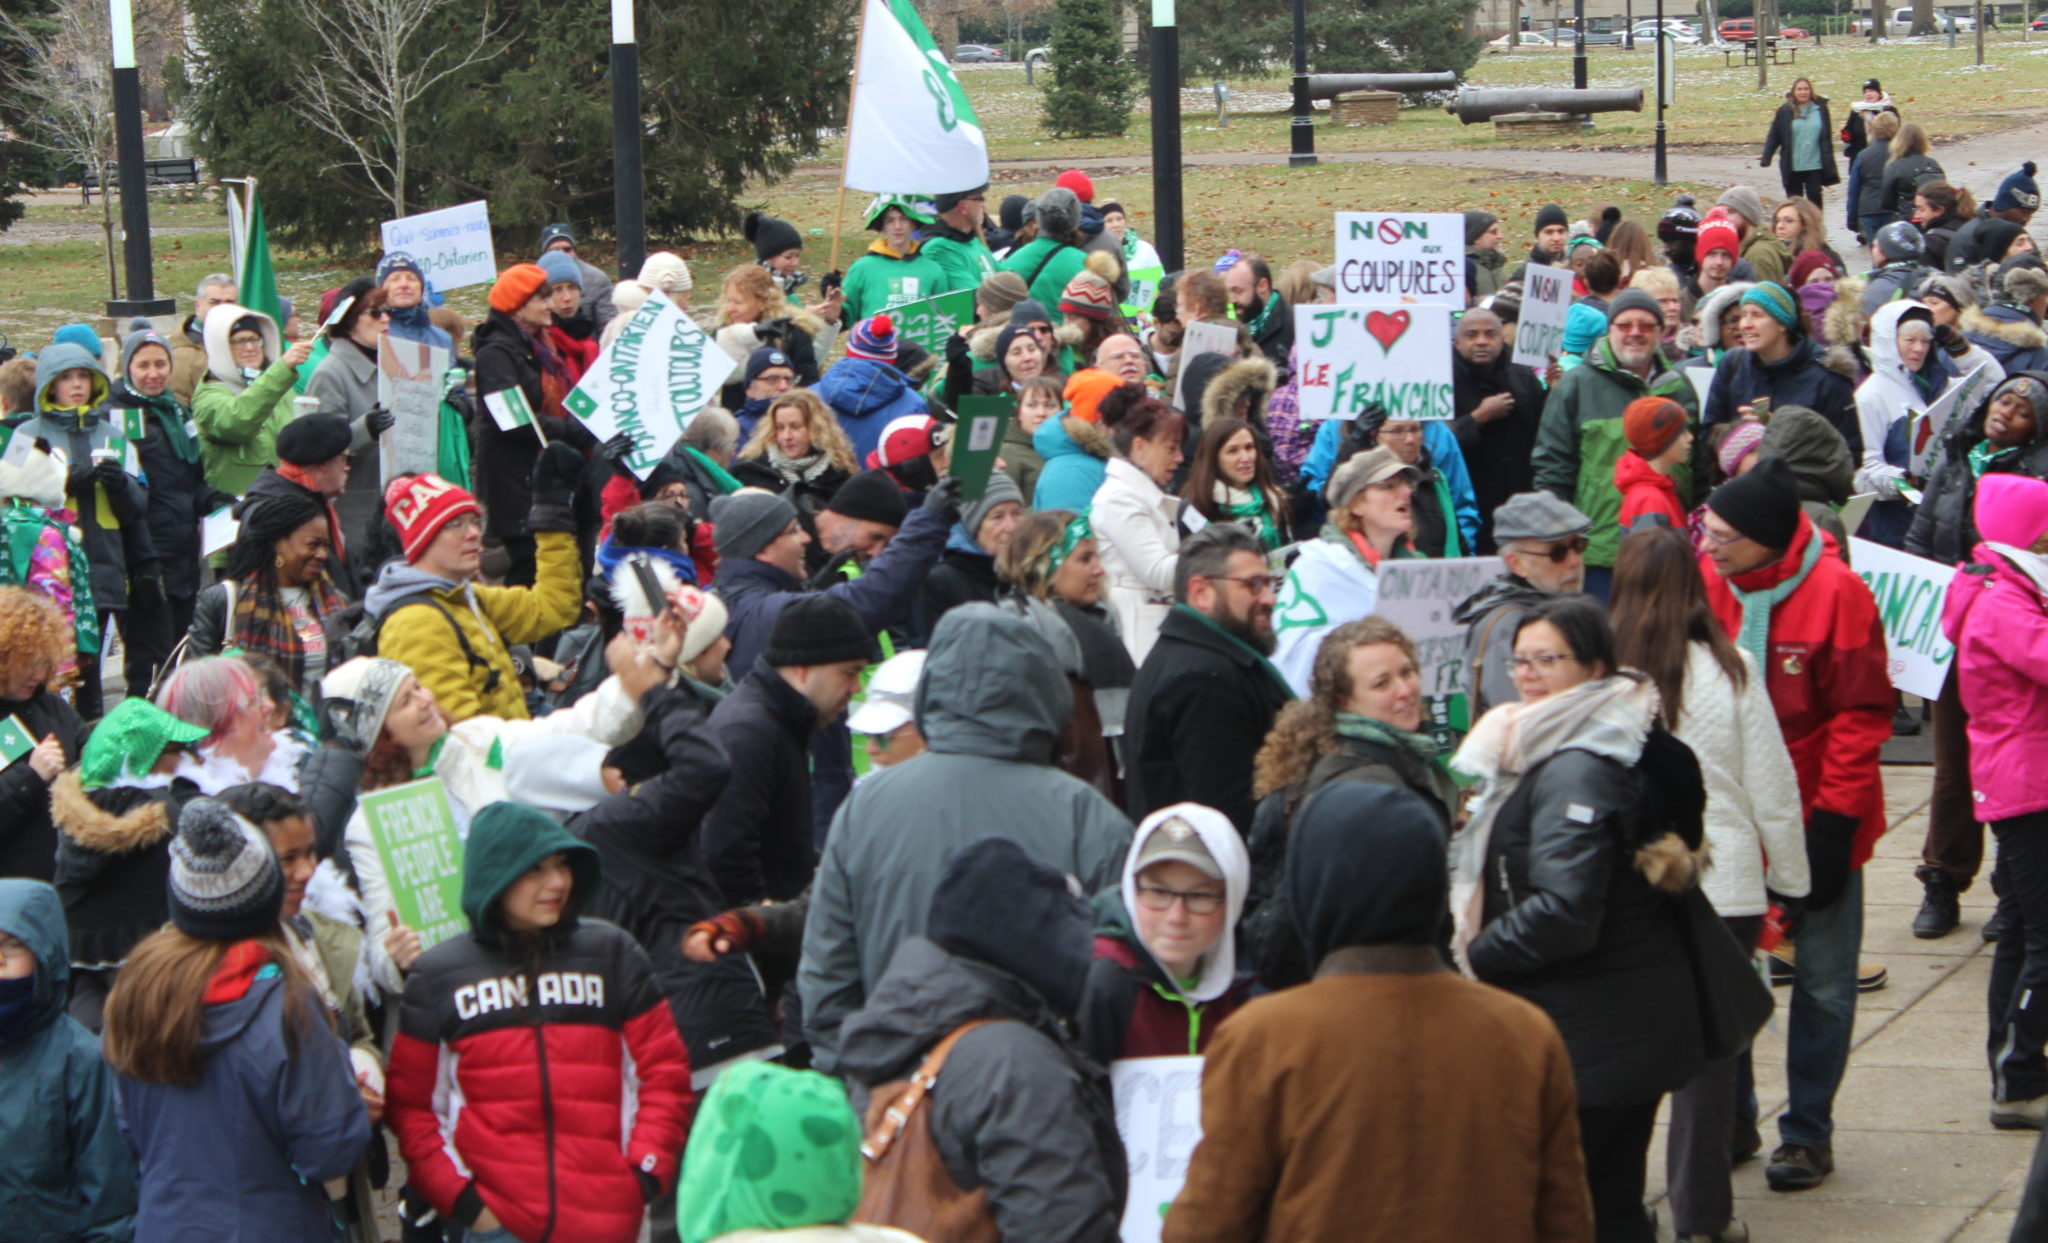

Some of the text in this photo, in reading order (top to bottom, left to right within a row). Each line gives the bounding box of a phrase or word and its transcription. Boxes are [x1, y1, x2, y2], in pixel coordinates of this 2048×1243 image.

[389, 226, 415, 247] Qui
[1350, 218, 1429, 245] NON
[1421, 245, 1442, 254] aux
[1341, 259, 1456, 295] COUPURES
[608, 299, 667, 471] FRANCO-ONTARIEN
[667, 318, 707, 432] TOUJOURS
[1302, 360, 1331, 387] LE
[1330, 362, 1454, 420] FRANÇAIS
[375, 792, 446, 846] FRENCH
[390, 833, 459, 890] PEOPLE
[414, 883, 449, 926] ARE
[454, 972, 605, 1021] CANADA
